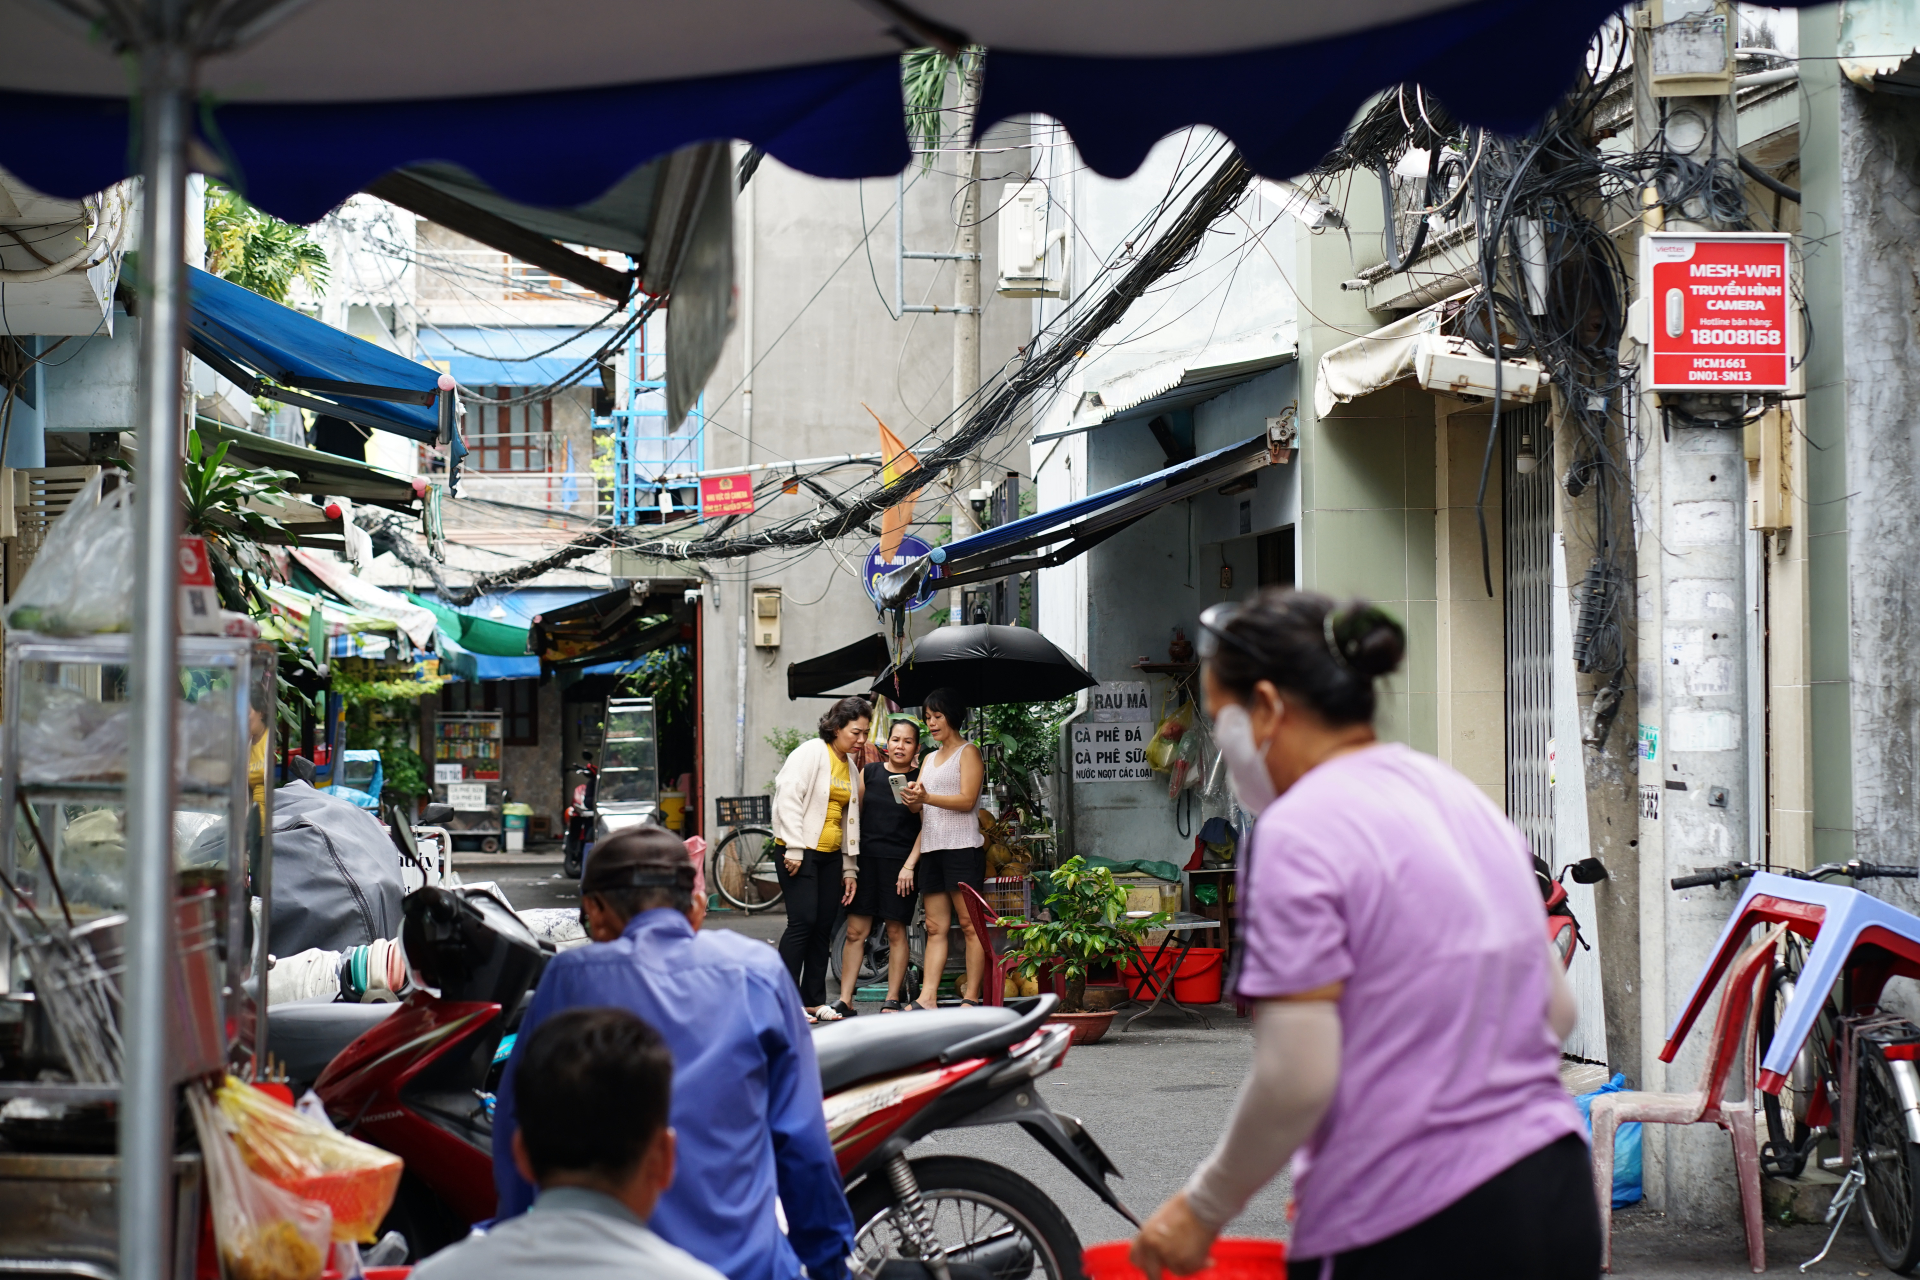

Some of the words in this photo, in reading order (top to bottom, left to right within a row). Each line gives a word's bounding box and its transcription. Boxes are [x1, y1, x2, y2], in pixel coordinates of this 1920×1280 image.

[1690, 264, 1781, 278] MESH-WIFI
[1747, 282, 1782, 296] HÌNH
[1706, 300, 1766, 311] CAMERA
[1700, 318, 1730, 326] Hotline
[1690, 329, 1781, 345] 18008168
[1693, 358, 1747, 369] HCM1661
[1688, 371, 1752, 381] DN01-SN13
[1095, 693, 1123, 709] RAU
[1127, 689, 1148, 709] MÁ
[1075, 727, 1091, 743] CÀ
[1096, 726, 1120, 743] PHÊ
[1125, 726, 1142, 742] ĐÁ
[1075, 749, 1092, 765] CÀ
[1096, 748, 1120, 764] PHÊ
[1125, 747, 1148, 764] SỮA
[1076, 767, 1096, 779] NƯỚC
[1098, 769, 1117, 780] NGỌT
[1119, 766, 1134, 778] CÁC
[1136, 768, 1153, 779] LOẠI
[361, 1109, 404, 1123] HONDA
